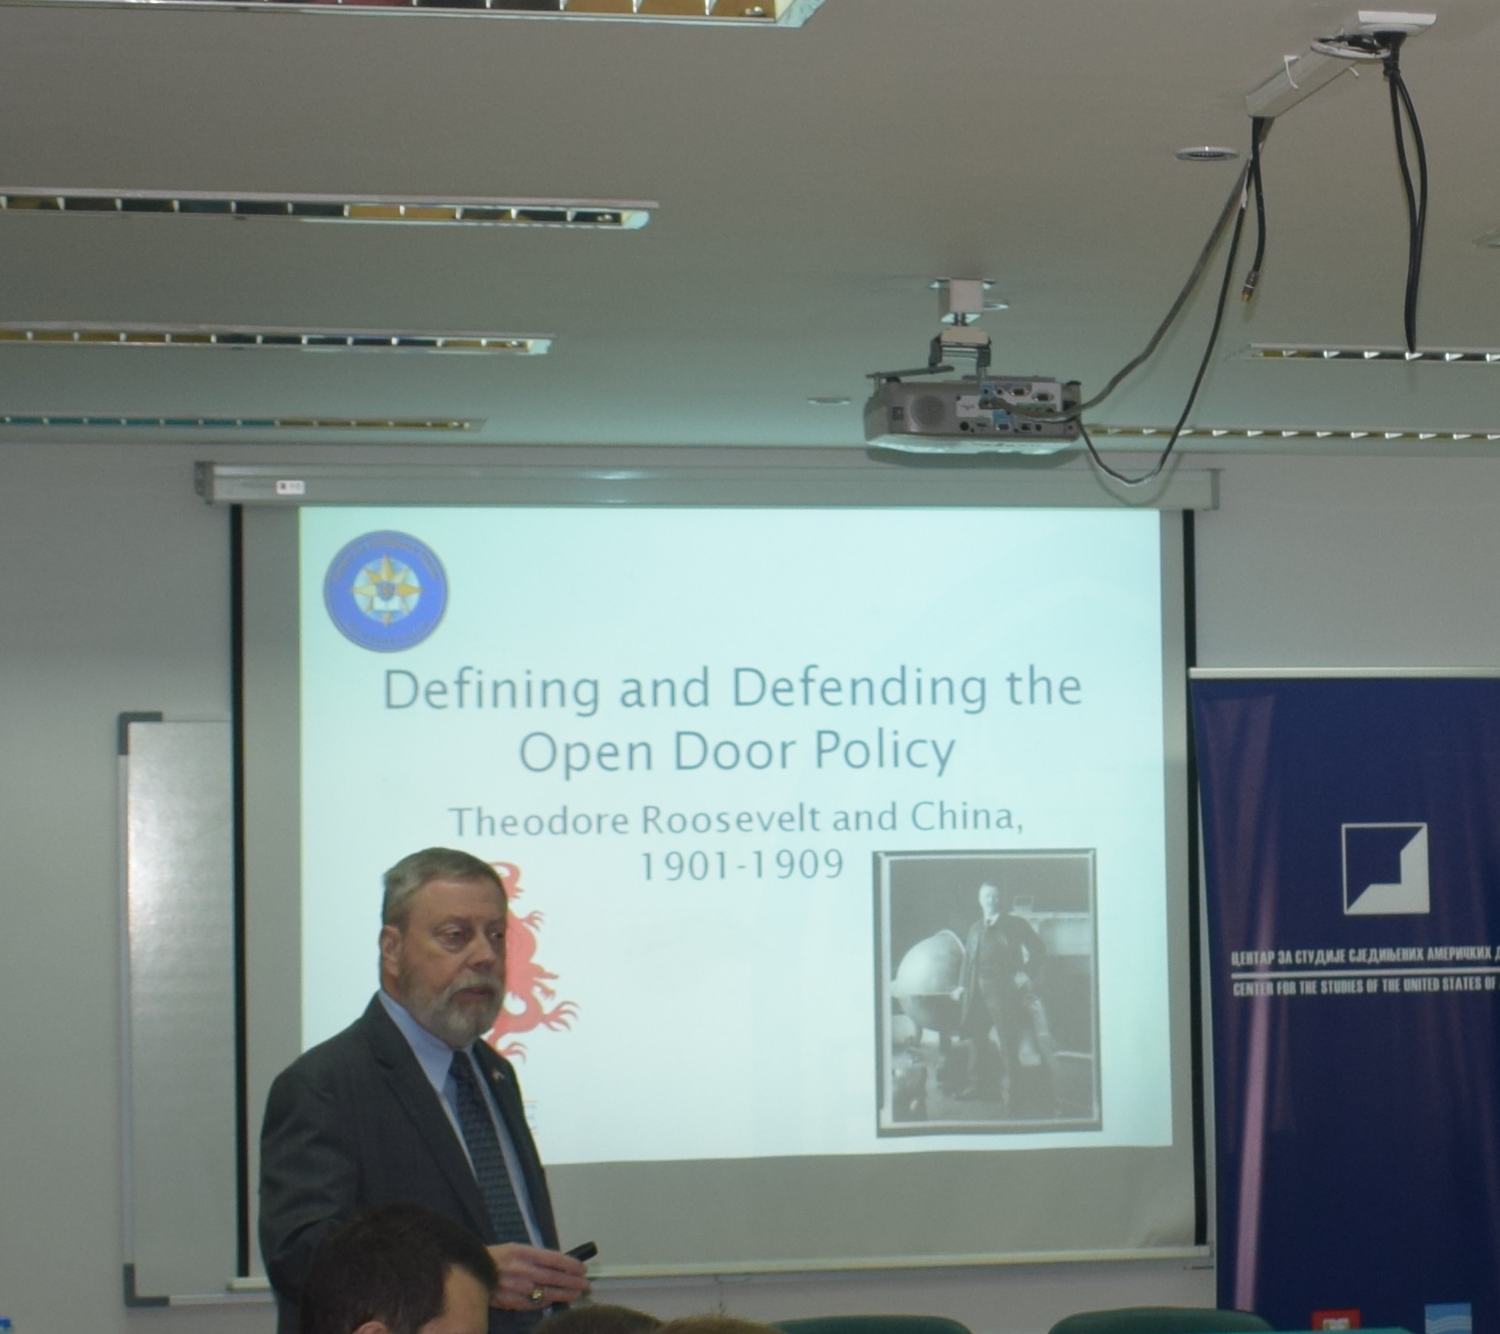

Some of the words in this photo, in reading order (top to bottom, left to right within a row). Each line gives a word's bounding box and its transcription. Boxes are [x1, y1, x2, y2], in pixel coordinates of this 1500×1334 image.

[384, 665, 599, 718] Defining
[619, 665, 709, 709] and
[733, 663, 987, 715] Defending
[1005, 663, 1083, 706] the
[519, 731, 653, 782] Open
[675, 730, 797, 772] Door
[816, 727, 957, 778] Policy
[448, 804, 629, 837] Theodore
[642, 801, 820, 835] Roosevelt
[832, 800, 897, 833] and
[910, 799, 1023, 835] China,
[642, 848, 844, 882] 1901-1909
[1231, 950, 1275, 966] ЦЕНТАР
[1278, 950, 1292, 965] ЗА
[1295, 948, 1346, 965] СТУДИЈЕ
[1349, 947, 1424, 965] СЈЕДИЊЕНИХ
[1427, 945, 1492, 962] АМЕРИЧКИХ
[1233, 981, 1274, 997] CENTER
[1276, 980, 1297, 995] FOR
[1300, 980, 1318, 995] THE
[1320, 979, 1364, 994] STUDIES
[1366, 978, 1379, 993] OF
[1382, 978, 1400, 993] THE
[1403, 977, 1440, 992] UNITED
[1442, 976, 1482, 991] STATES
[1484, 976, 1496, 991] OF
